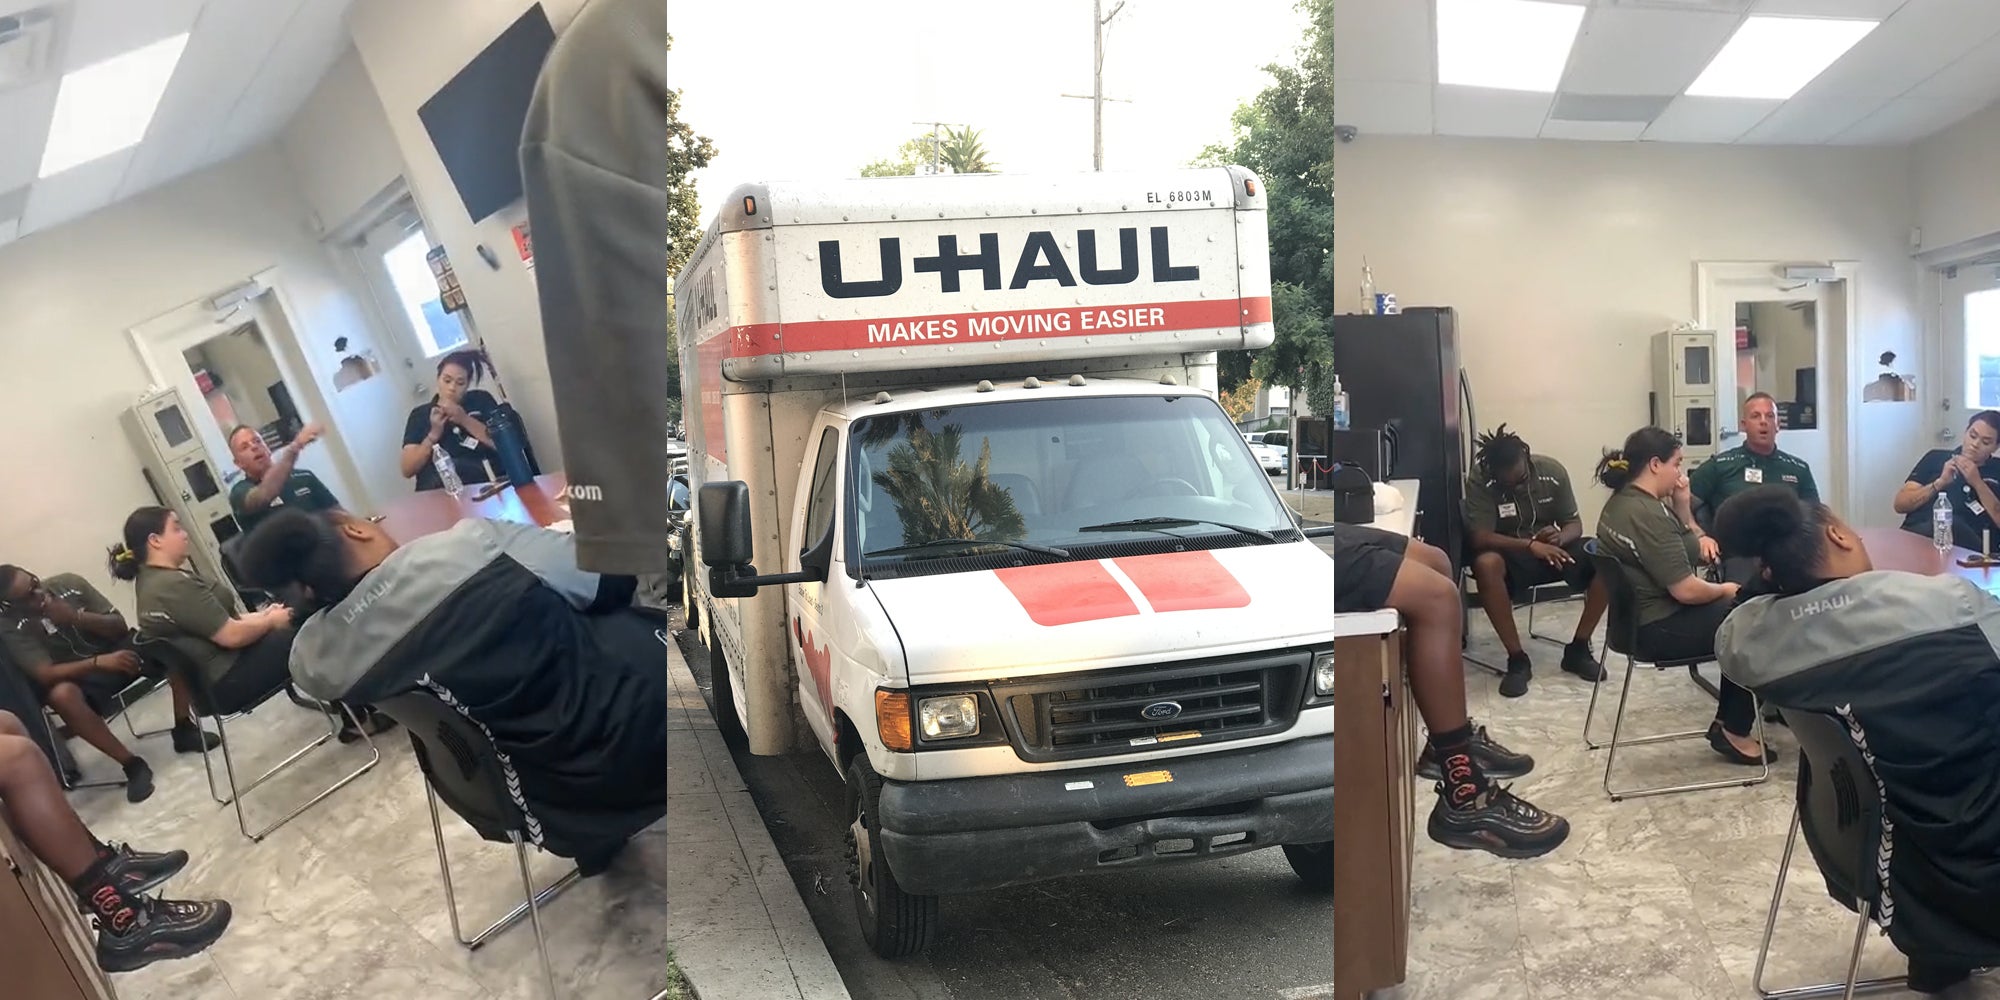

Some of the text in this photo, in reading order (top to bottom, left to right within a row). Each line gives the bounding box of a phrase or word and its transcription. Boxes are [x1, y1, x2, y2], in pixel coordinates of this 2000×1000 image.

[1147, 190, 1212, 203] EL 6803M
[818, 226, 1200, 299] U-HAUL
[867, 308, 1165, 343] MAKES MOVING EASIER
[1790, 594, 1854, 621] U-HAUL
[1151, 705, 1172, 717] Ford
